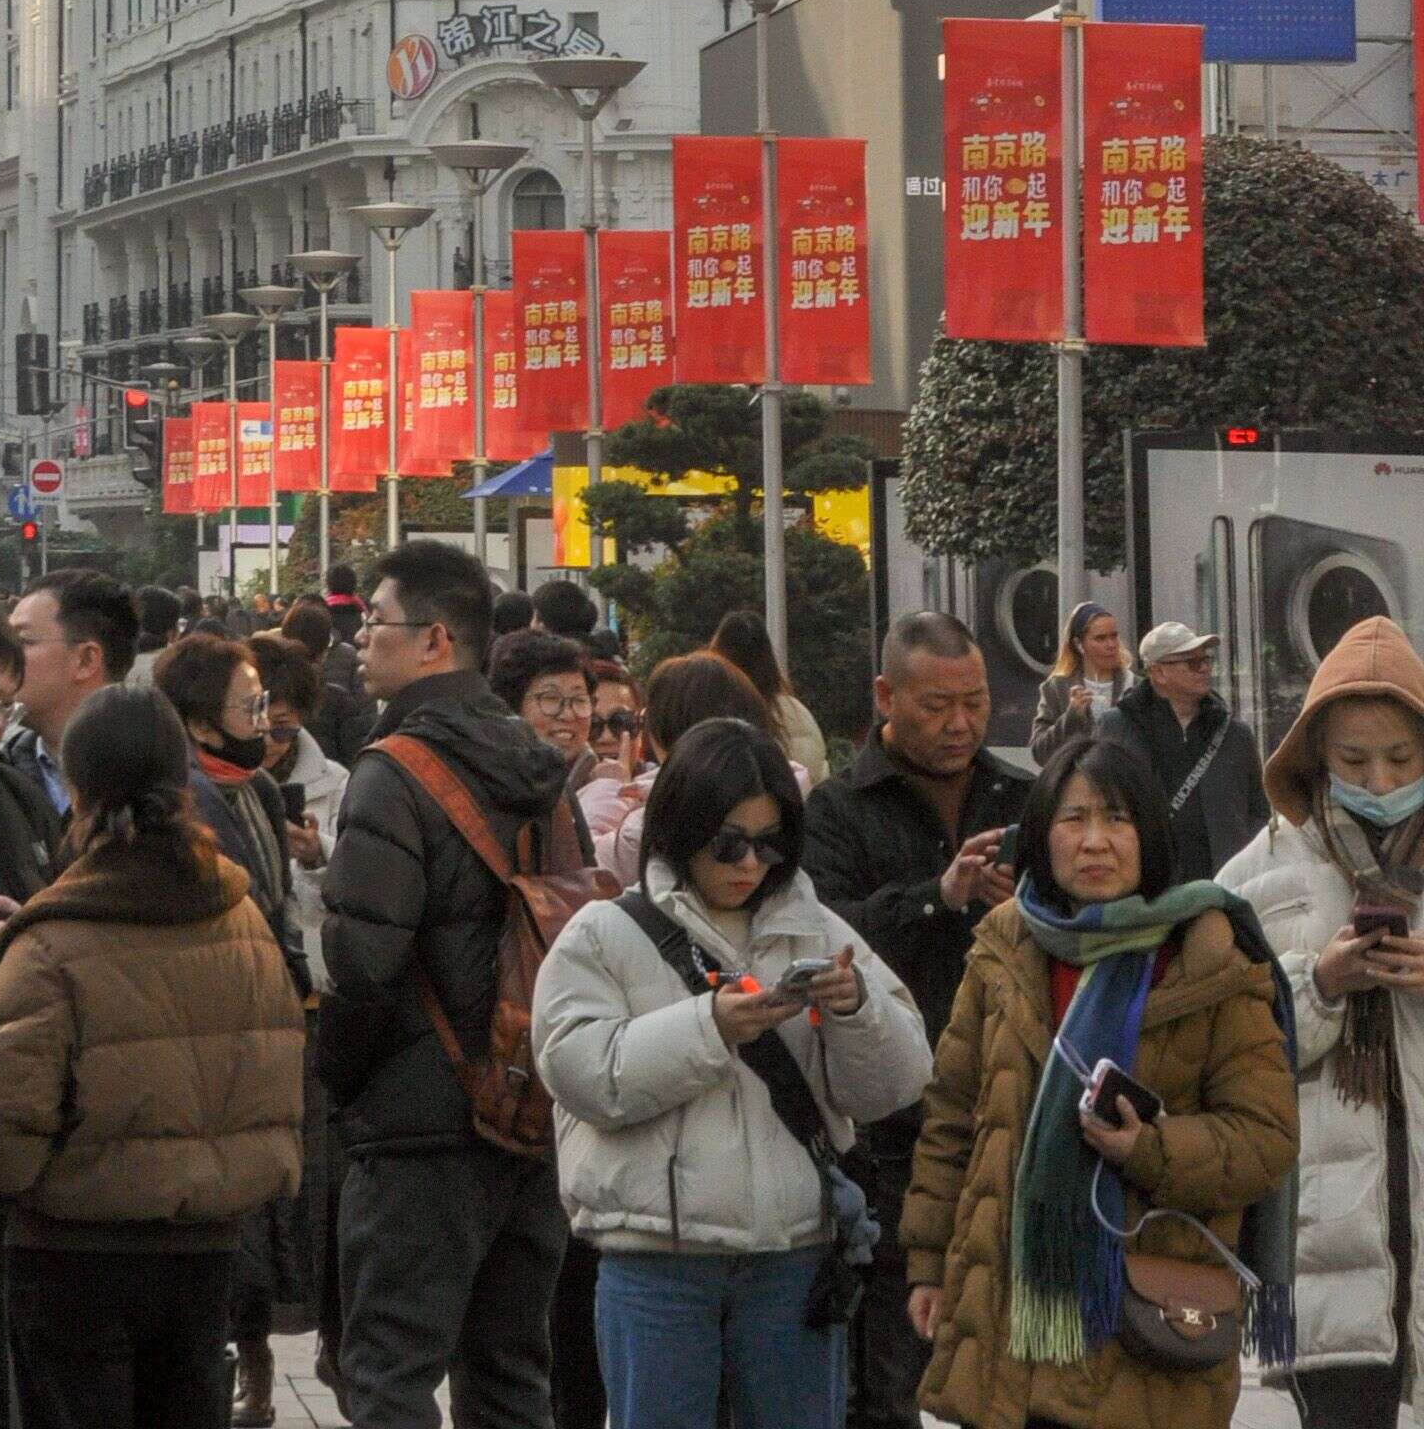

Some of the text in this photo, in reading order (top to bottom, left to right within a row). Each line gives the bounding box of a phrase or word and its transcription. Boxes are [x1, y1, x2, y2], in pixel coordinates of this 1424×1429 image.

[962, 131, 1047, 171] 南京路
[1101, 136, 1186, 175] 南京路
[960, 201, 1052, 240] 迎新年
[1100, 205, 1191, 244] 迎新年
[687, 223, 751, 255] 南京路
[792, 224, 856, 256] 南京路
[687, 277, 756, 308] 迎新年
[791, 278, 861, 310] 迎新年
[525, 300, 577, 326] 南京路
[610, 300, 662, 325] 南京路
[420, 349, 466, 372] 南京路
[524, 344, 581, 370] 迎新年
[609, 344, 667, 370] 迎新年
[419, 386, 468, 409] 迎新年
